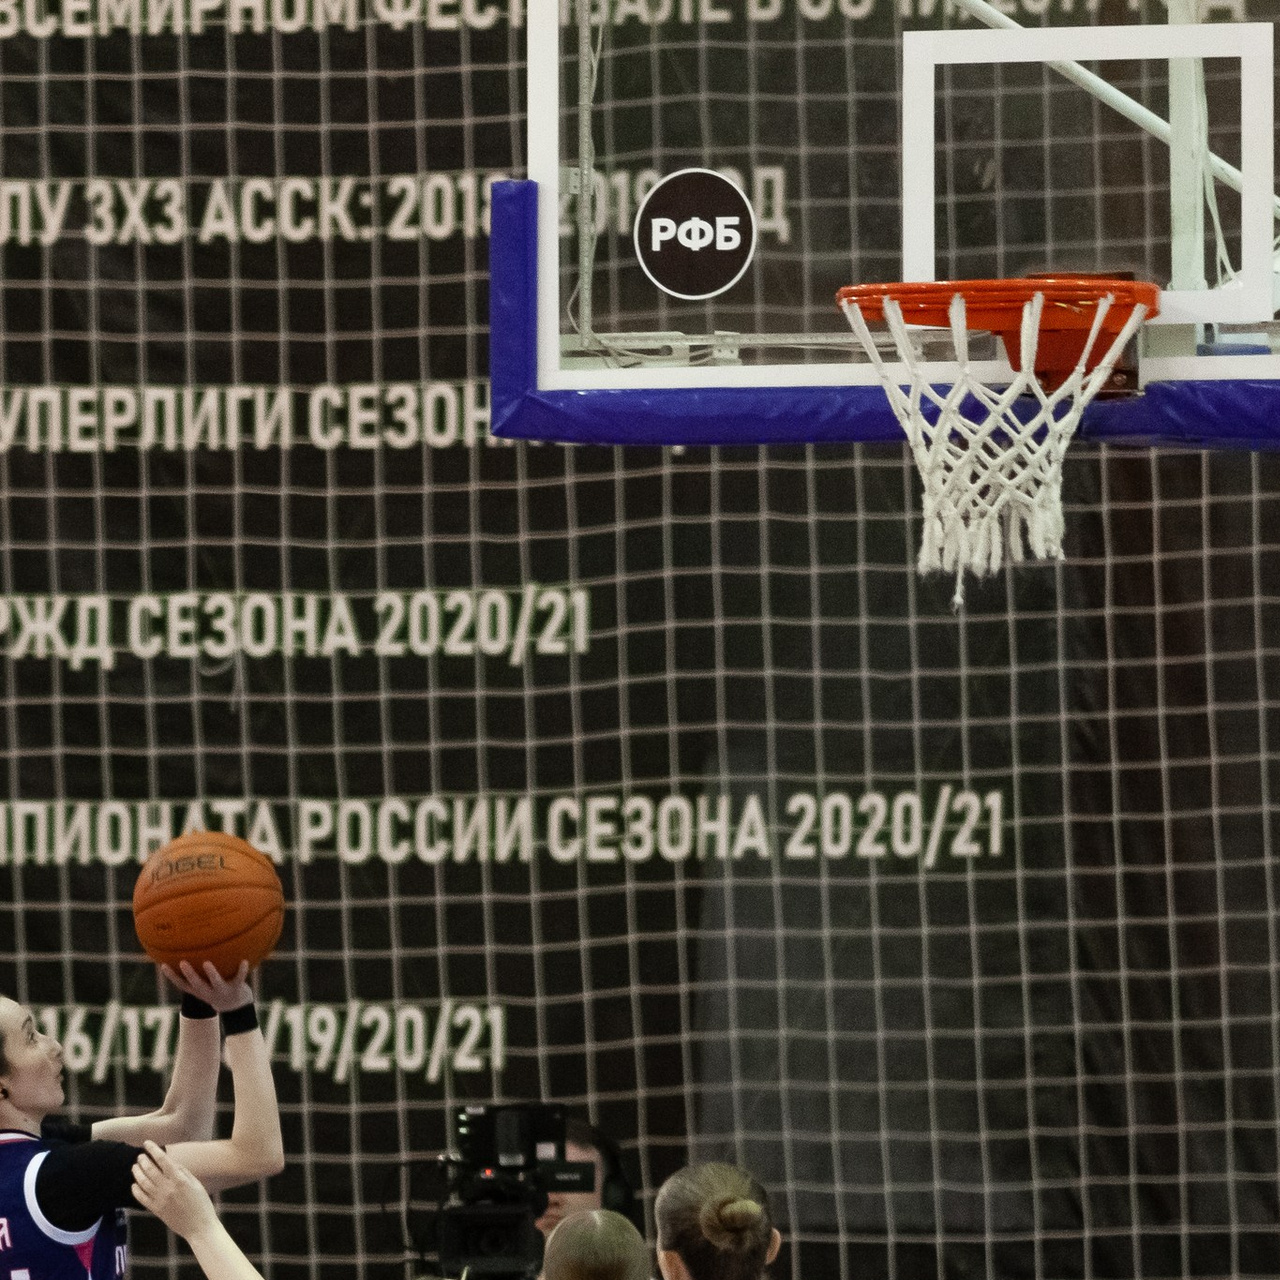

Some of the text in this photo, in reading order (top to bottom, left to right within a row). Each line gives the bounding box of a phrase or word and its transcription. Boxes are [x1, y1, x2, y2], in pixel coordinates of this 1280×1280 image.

[200, 174, 375, 244] АССК:
[651, 216, 741, 251] РФБ
[308, 382, 492, 450] СЕЗОН
[128, 590, 361, 658] СЕЗОНА
[373, 583, 591, 667] 2020/21
[298, 797, 534, 864] РОССИИ
[547, 793, 770, 863] СЕЗОНА
[783, 784, 1005, 869] 2020/21
